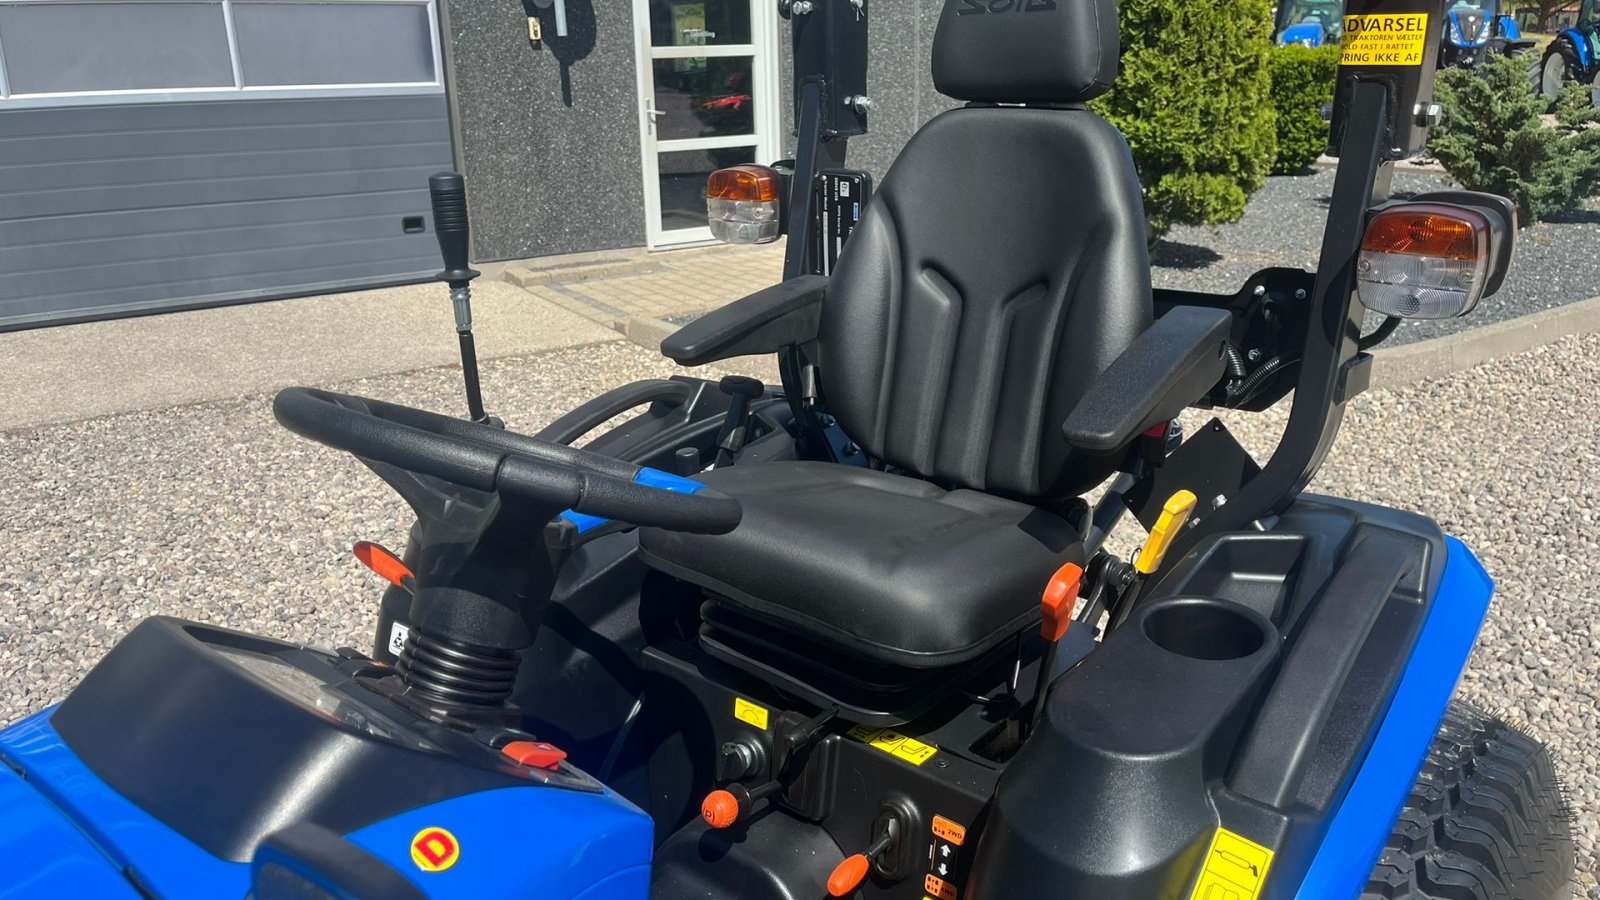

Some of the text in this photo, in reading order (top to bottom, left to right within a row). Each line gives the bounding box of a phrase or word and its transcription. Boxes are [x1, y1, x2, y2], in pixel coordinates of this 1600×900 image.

[1339, 53, 1419, 62] PRING IKKE AF
[948, 828, 962, 840] 2WD
[414, 831, 455, 868] D
